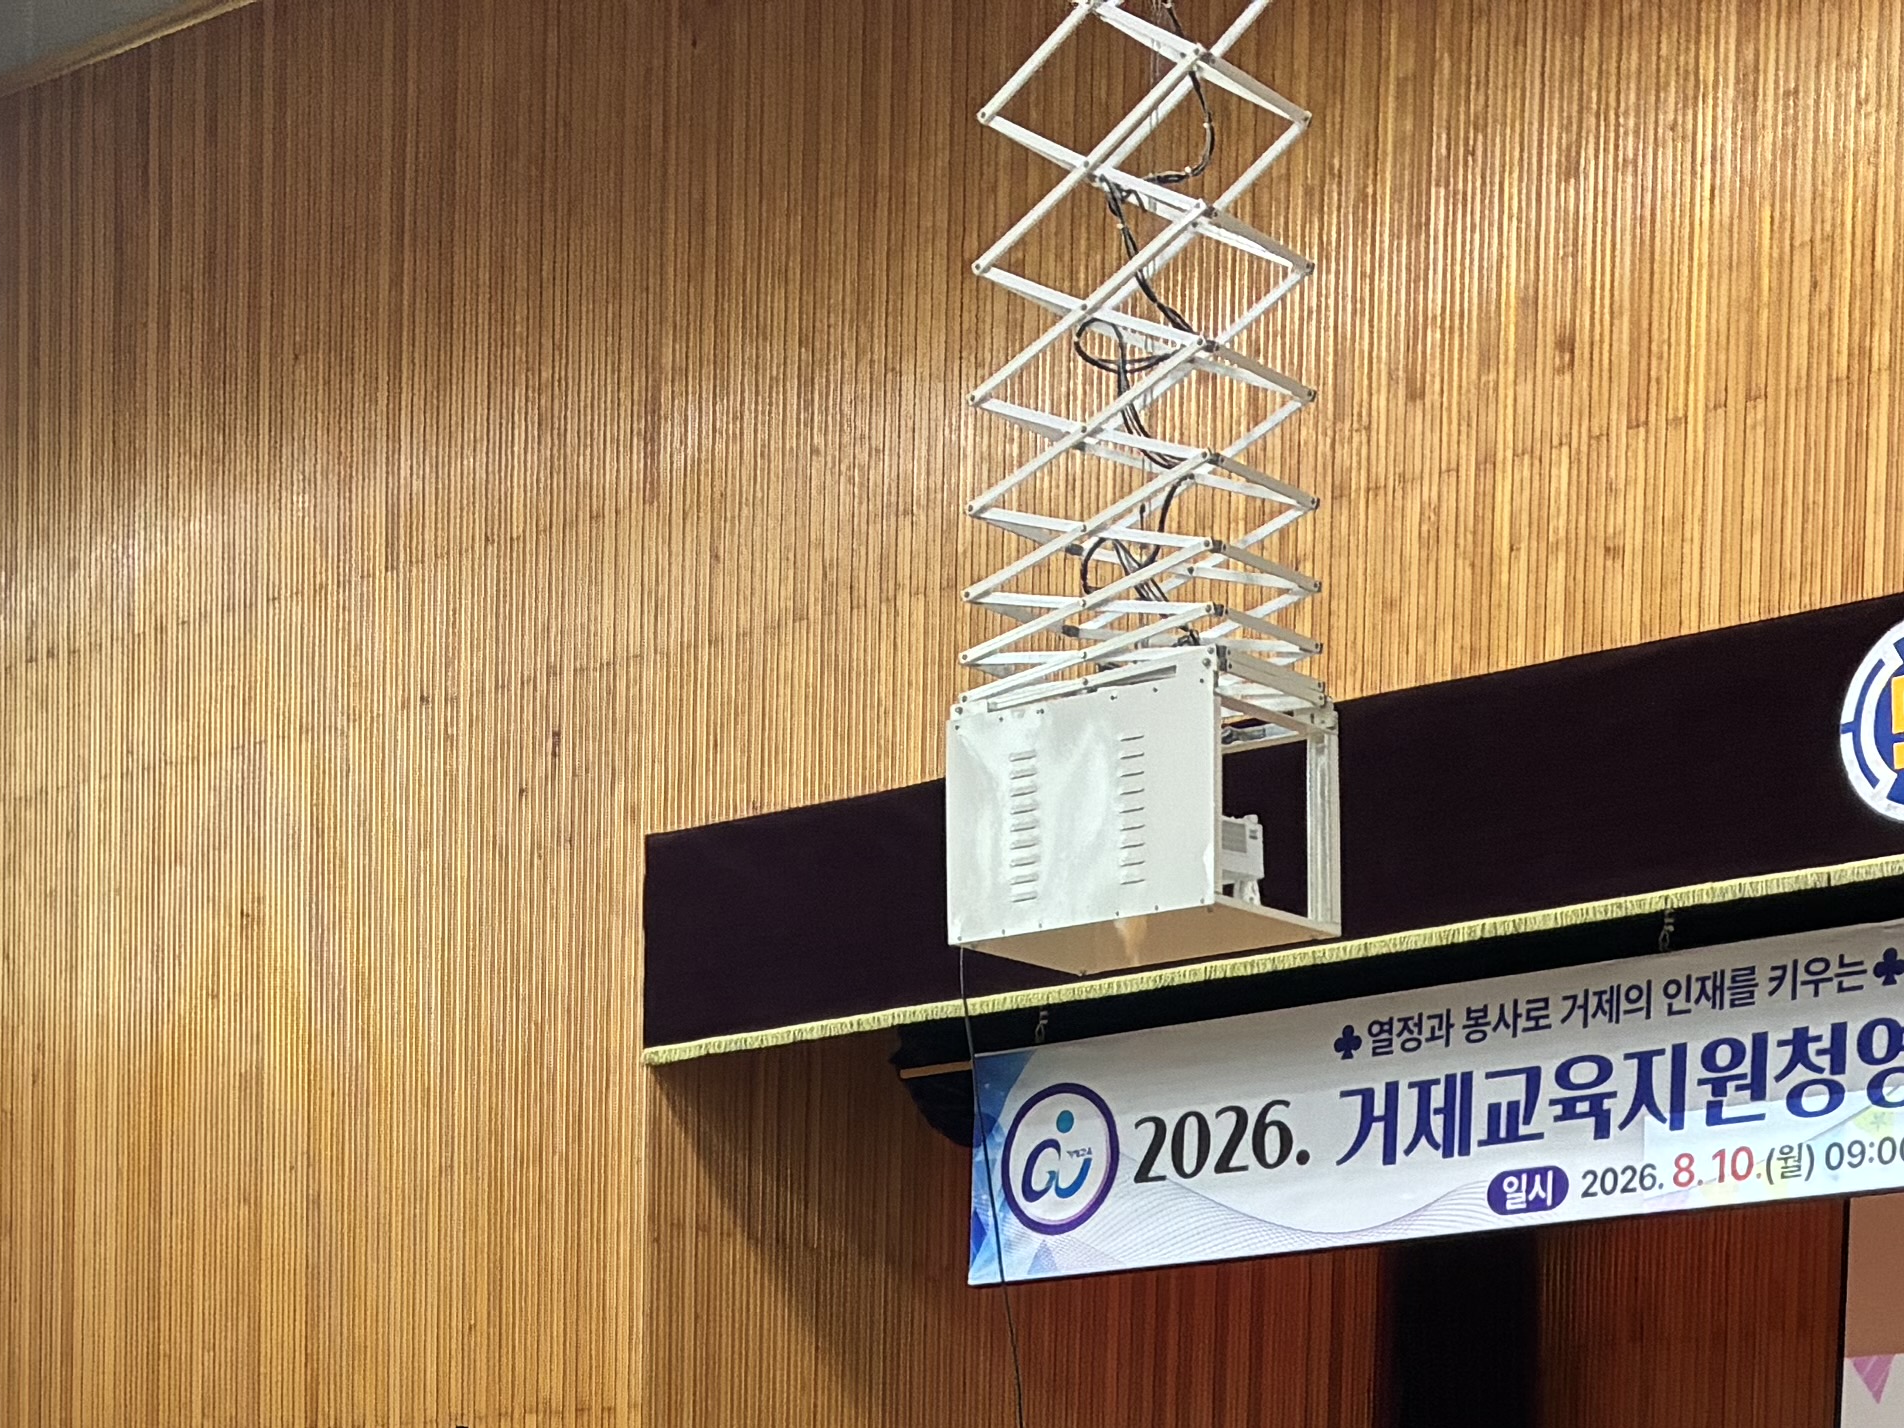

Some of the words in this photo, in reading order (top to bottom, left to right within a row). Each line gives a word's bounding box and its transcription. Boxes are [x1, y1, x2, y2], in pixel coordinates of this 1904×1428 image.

[1367, 1008, 1454, 1057] 열정과
[1462, 997, 1552, 1044] 봉사로
[1560, 978, 1653, 1030] 거제의
[1662, 965, 1759, 1017] 인재를
[1768, 953, 1868, 1001] 키우는
[1133, 1099, 1310, 1186] 2026.
[1501, 1173, 1554, 1211] 일시
